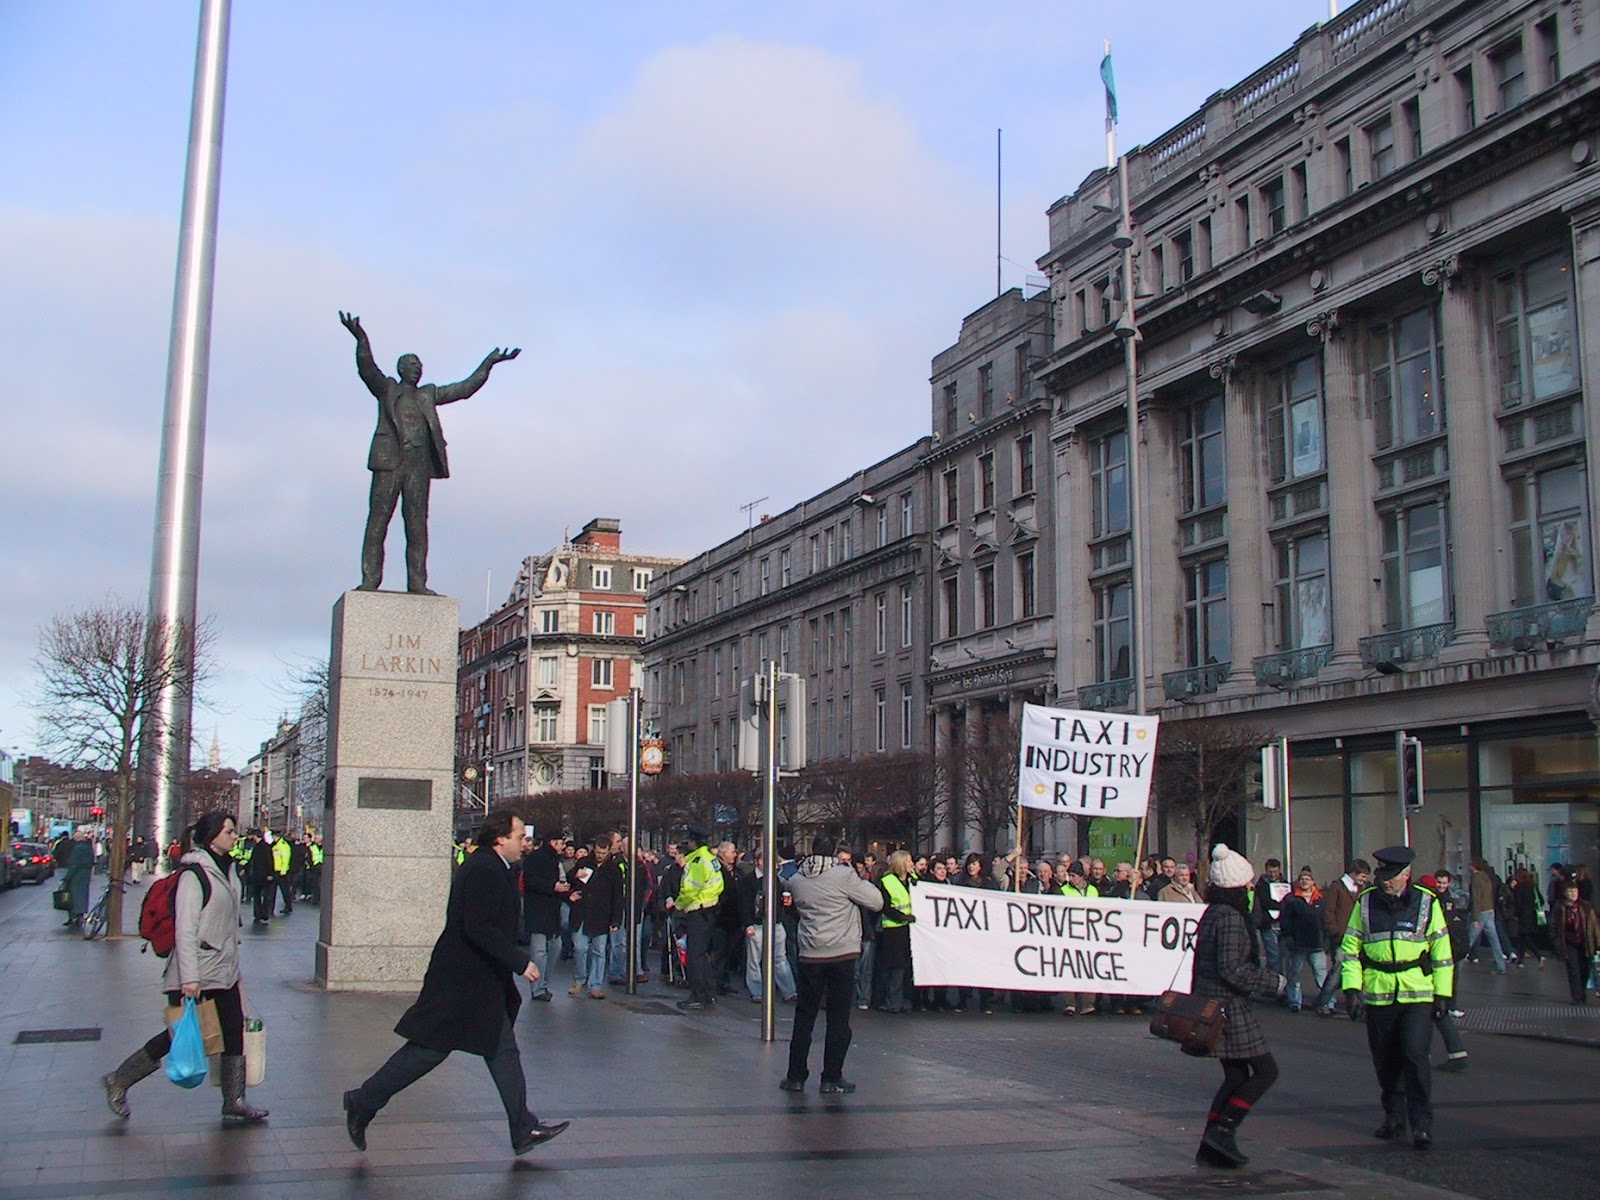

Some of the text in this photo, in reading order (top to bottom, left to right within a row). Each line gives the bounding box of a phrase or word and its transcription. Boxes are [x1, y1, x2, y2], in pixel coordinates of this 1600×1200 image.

[384, 634, 421, 650] JIM
[361, 654, 440, 673] LARKIN
[369, 688, 428, 699] 1874-1947
[1050, 716, 1129, 745] TAXI
[1025, 745, 1148, 778] INDUSTRY
[925, 895, 1199, 951] TAXI DRIVERS FOR
[1013, 945, 1128, 981] CHANGE
